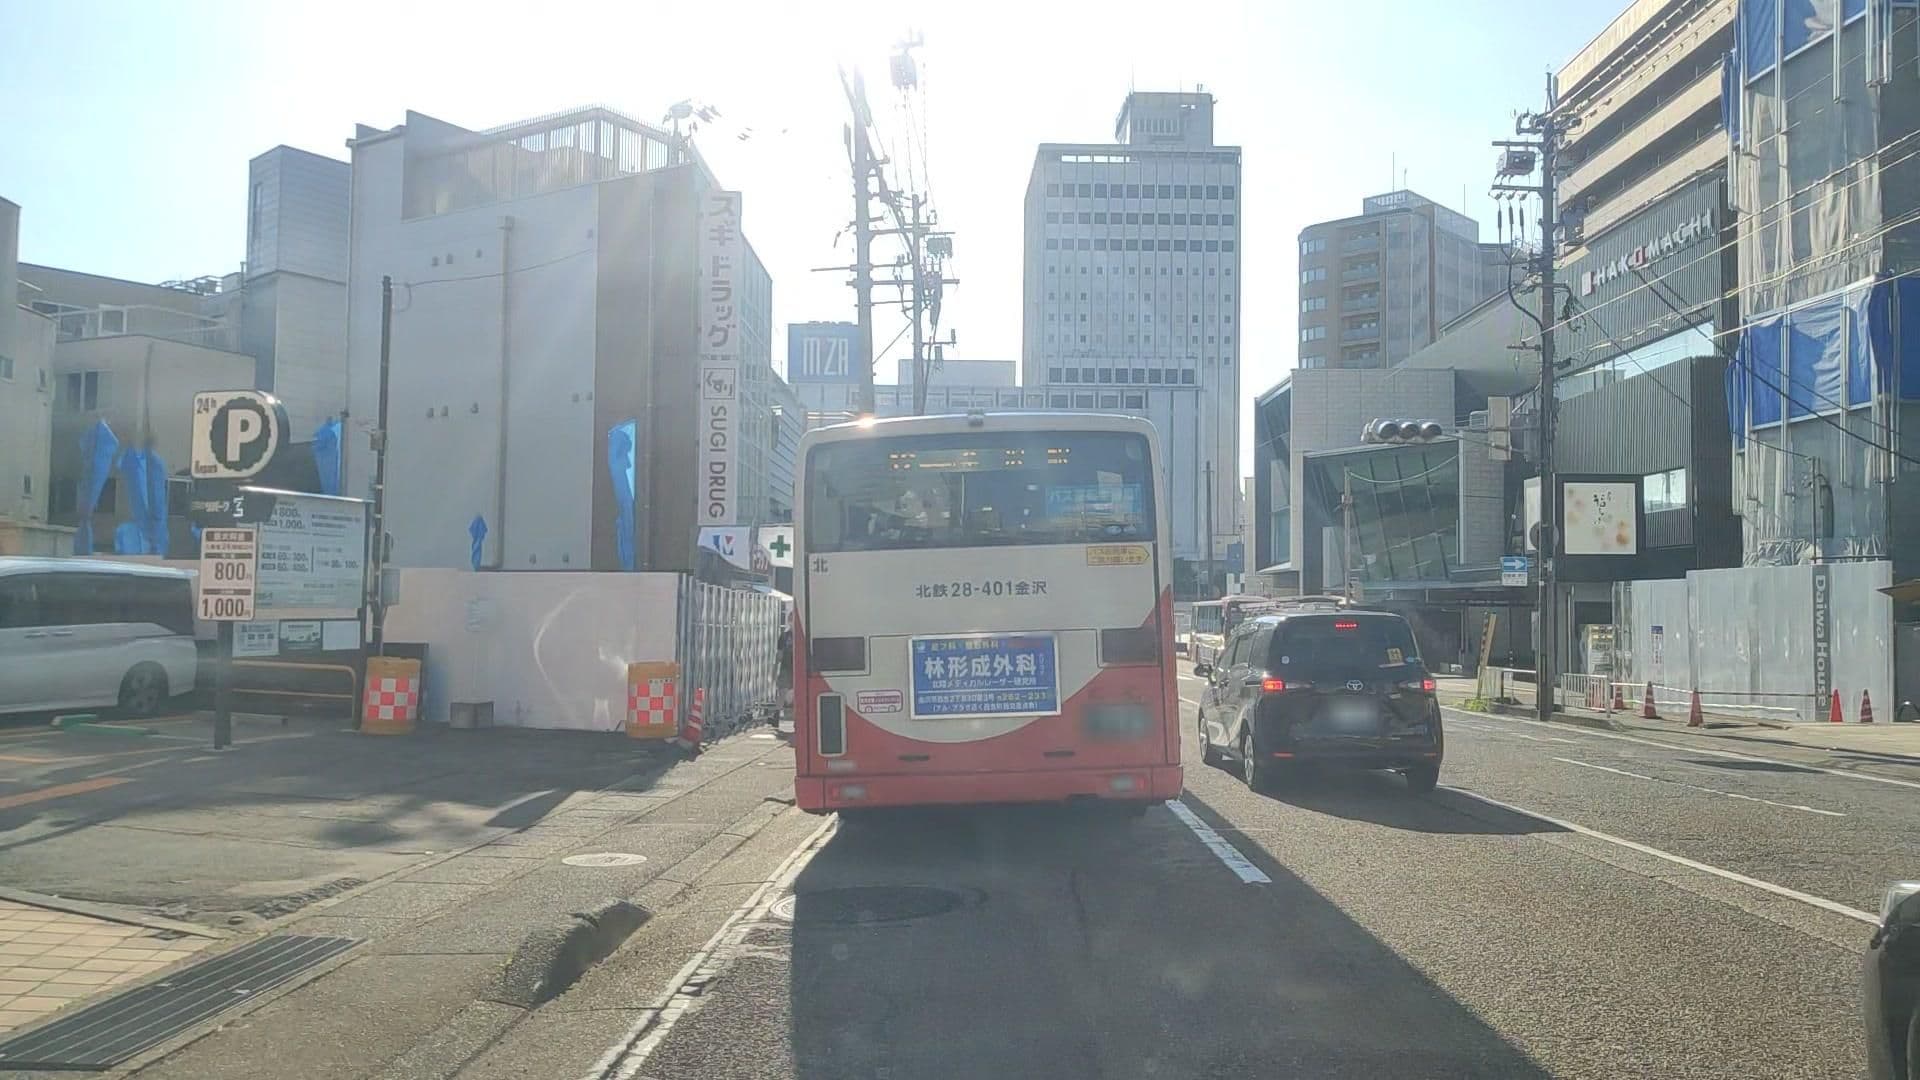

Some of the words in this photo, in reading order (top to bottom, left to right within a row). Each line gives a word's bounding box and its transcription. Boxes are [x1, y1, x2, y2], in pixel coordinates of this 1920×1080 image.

[708, 196, 737, 348] スギドラッグ
[226, 409, 262, 462] P
[710, 405, 728, 452] SUGI
[708, 461, 727, 519] DRUG
[813, 558, 829, 573] 北
[1815, 575, 1827, 639] Daiwa
[924, 653, 1037, 679] 林形成外科
[1816, 642, 1828, 707] House
